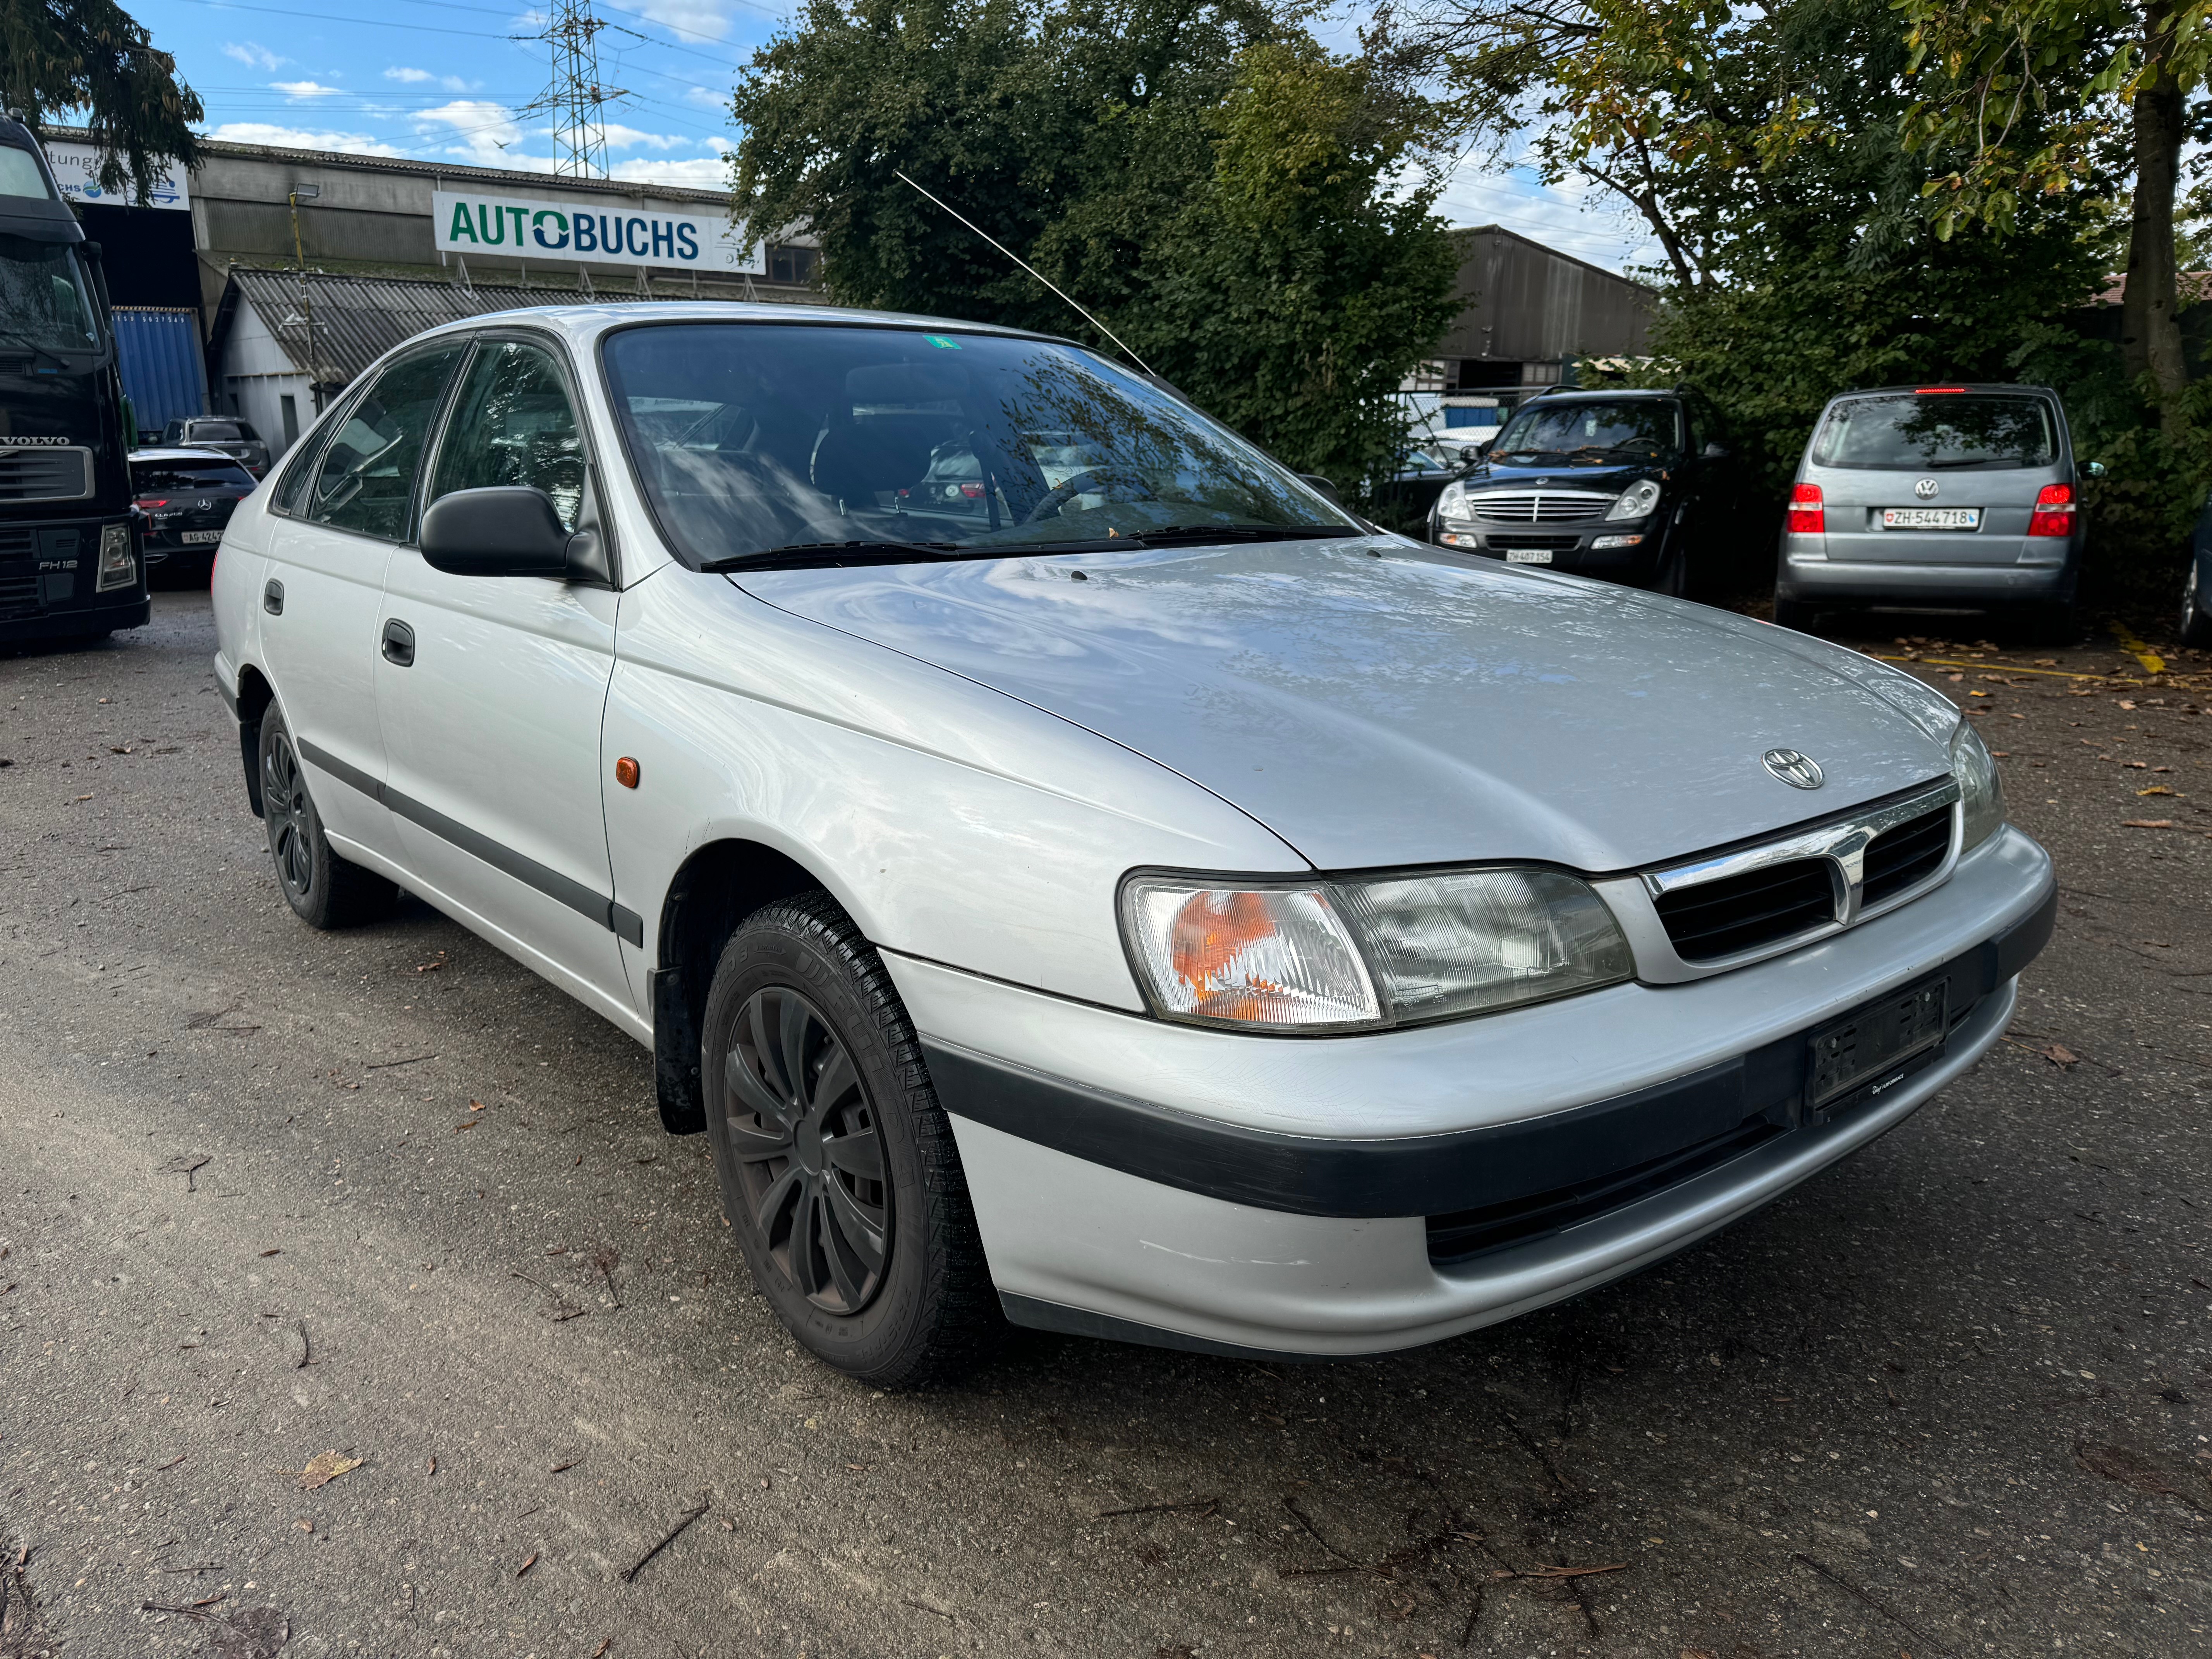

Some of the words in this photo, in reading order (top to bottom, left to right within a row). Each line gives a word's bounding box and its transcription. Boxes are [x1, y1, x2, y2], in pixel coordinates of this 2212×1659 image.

[449, 202, 699, 260] AUTOBUCHS
[0, 436, 70, 445] VOLVO
[818, 979, 914, 1188] FULDA
